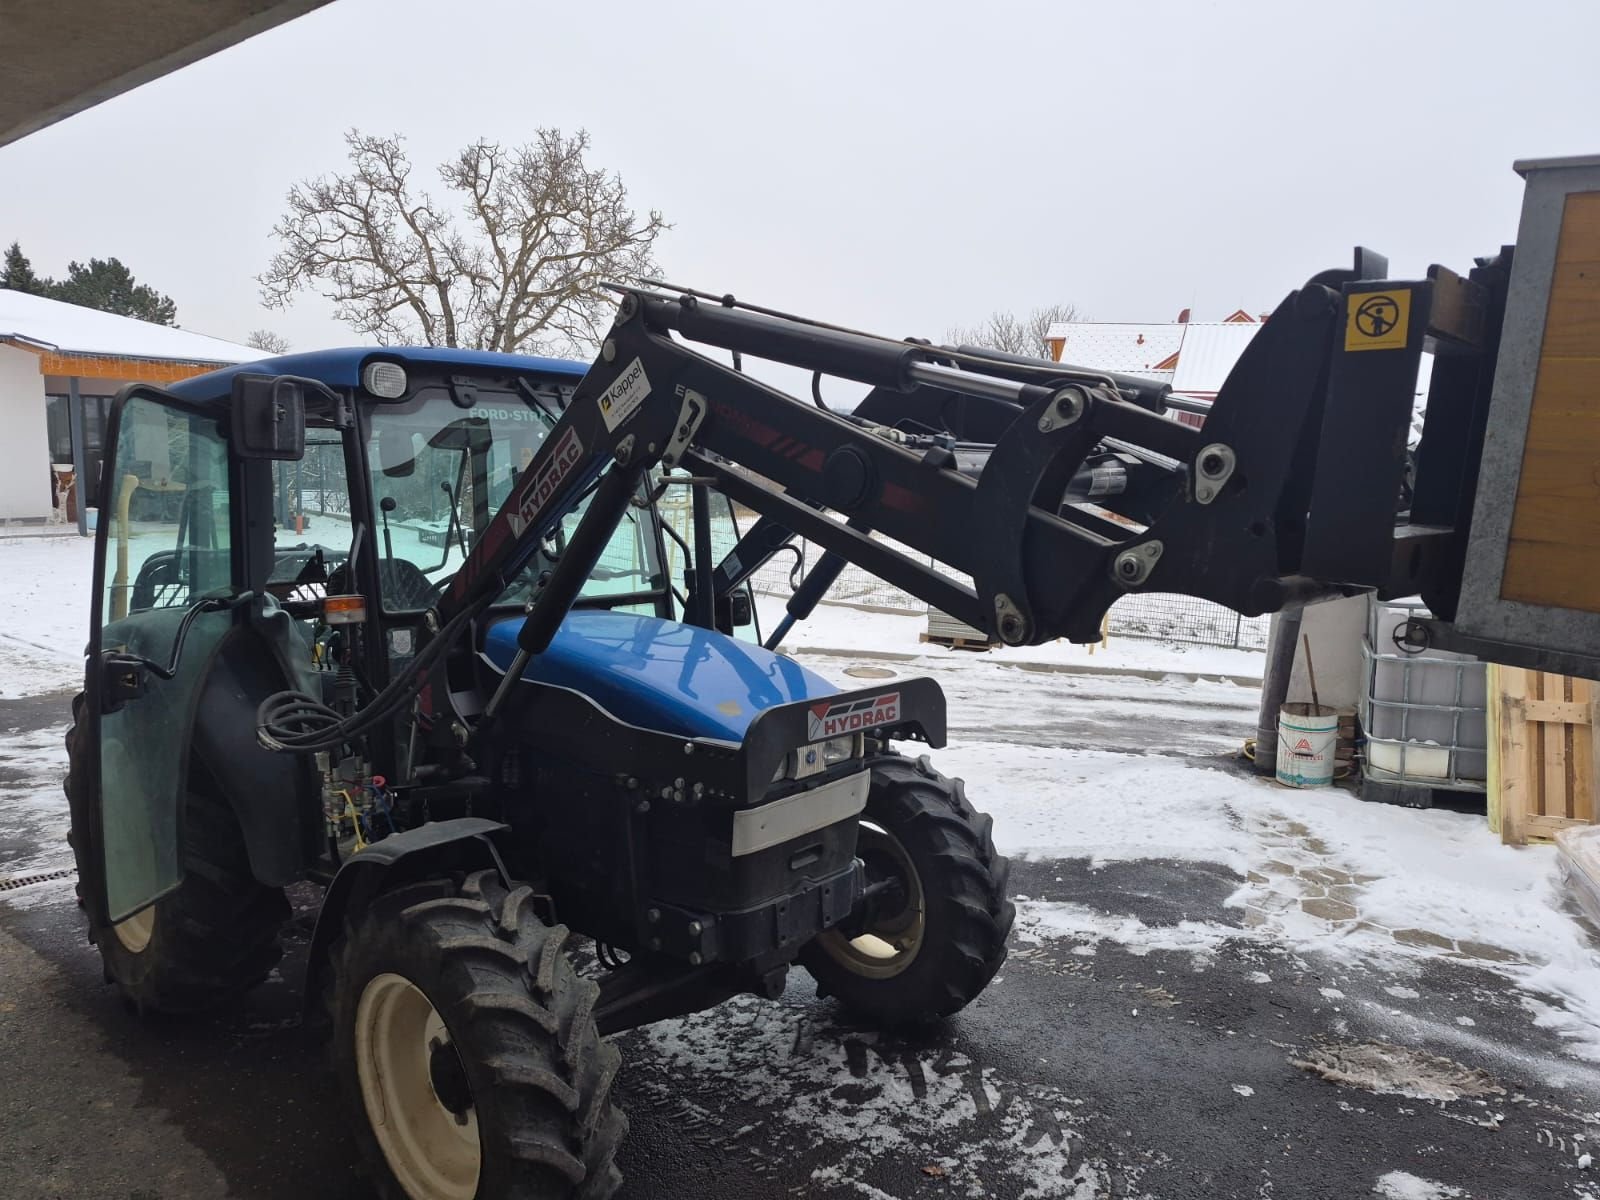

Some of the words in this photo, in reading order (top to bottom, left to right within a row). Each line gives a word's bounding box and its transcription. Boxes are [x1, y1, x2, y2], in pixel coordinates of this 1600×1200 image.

[609, 361, 642, 402] Kappel
[520, 443, 580, 524] HYDRAC
[824, 705, 897, 735] HYDRAC
